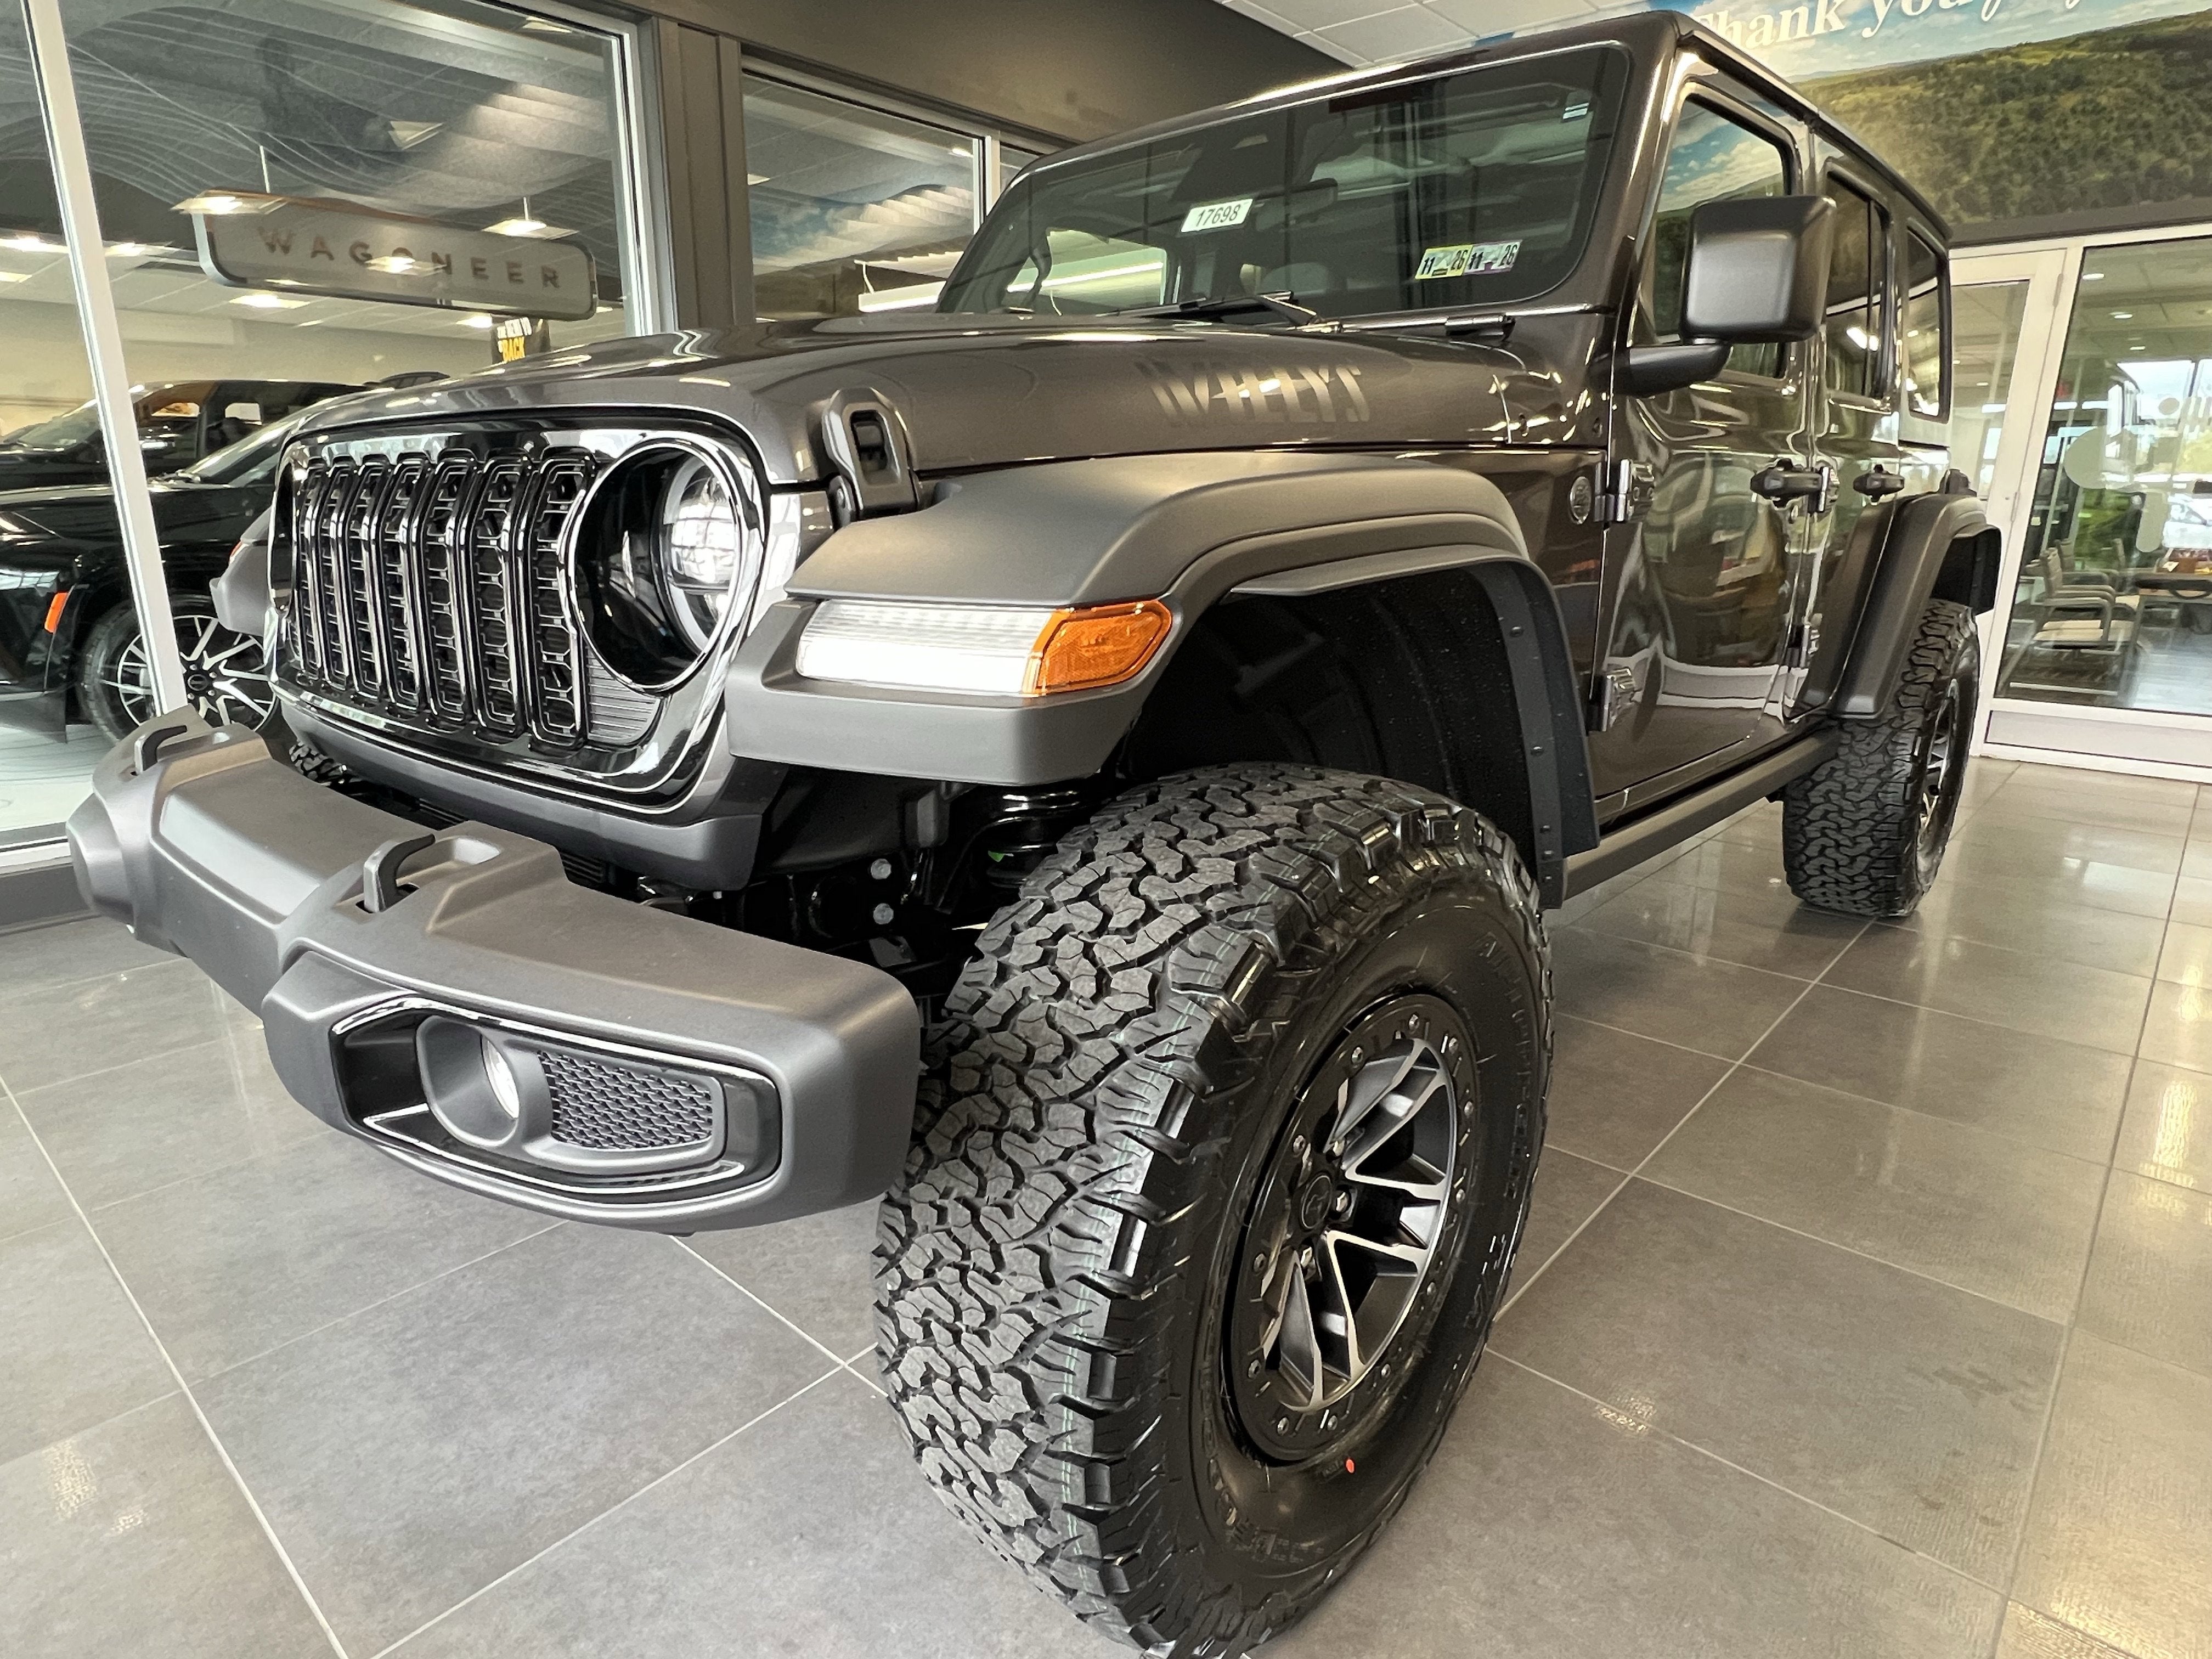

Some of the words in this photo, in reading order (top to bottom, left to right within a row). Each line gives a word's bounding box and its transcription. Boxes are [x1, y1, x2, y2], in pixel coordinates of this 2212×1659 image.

[1195, 204, 1241, 227] 17698
[1421, 256, 1436, 275] 11
[1469, 251, 1484, 270] 11
[1498, 244, 1518, 267] 26
